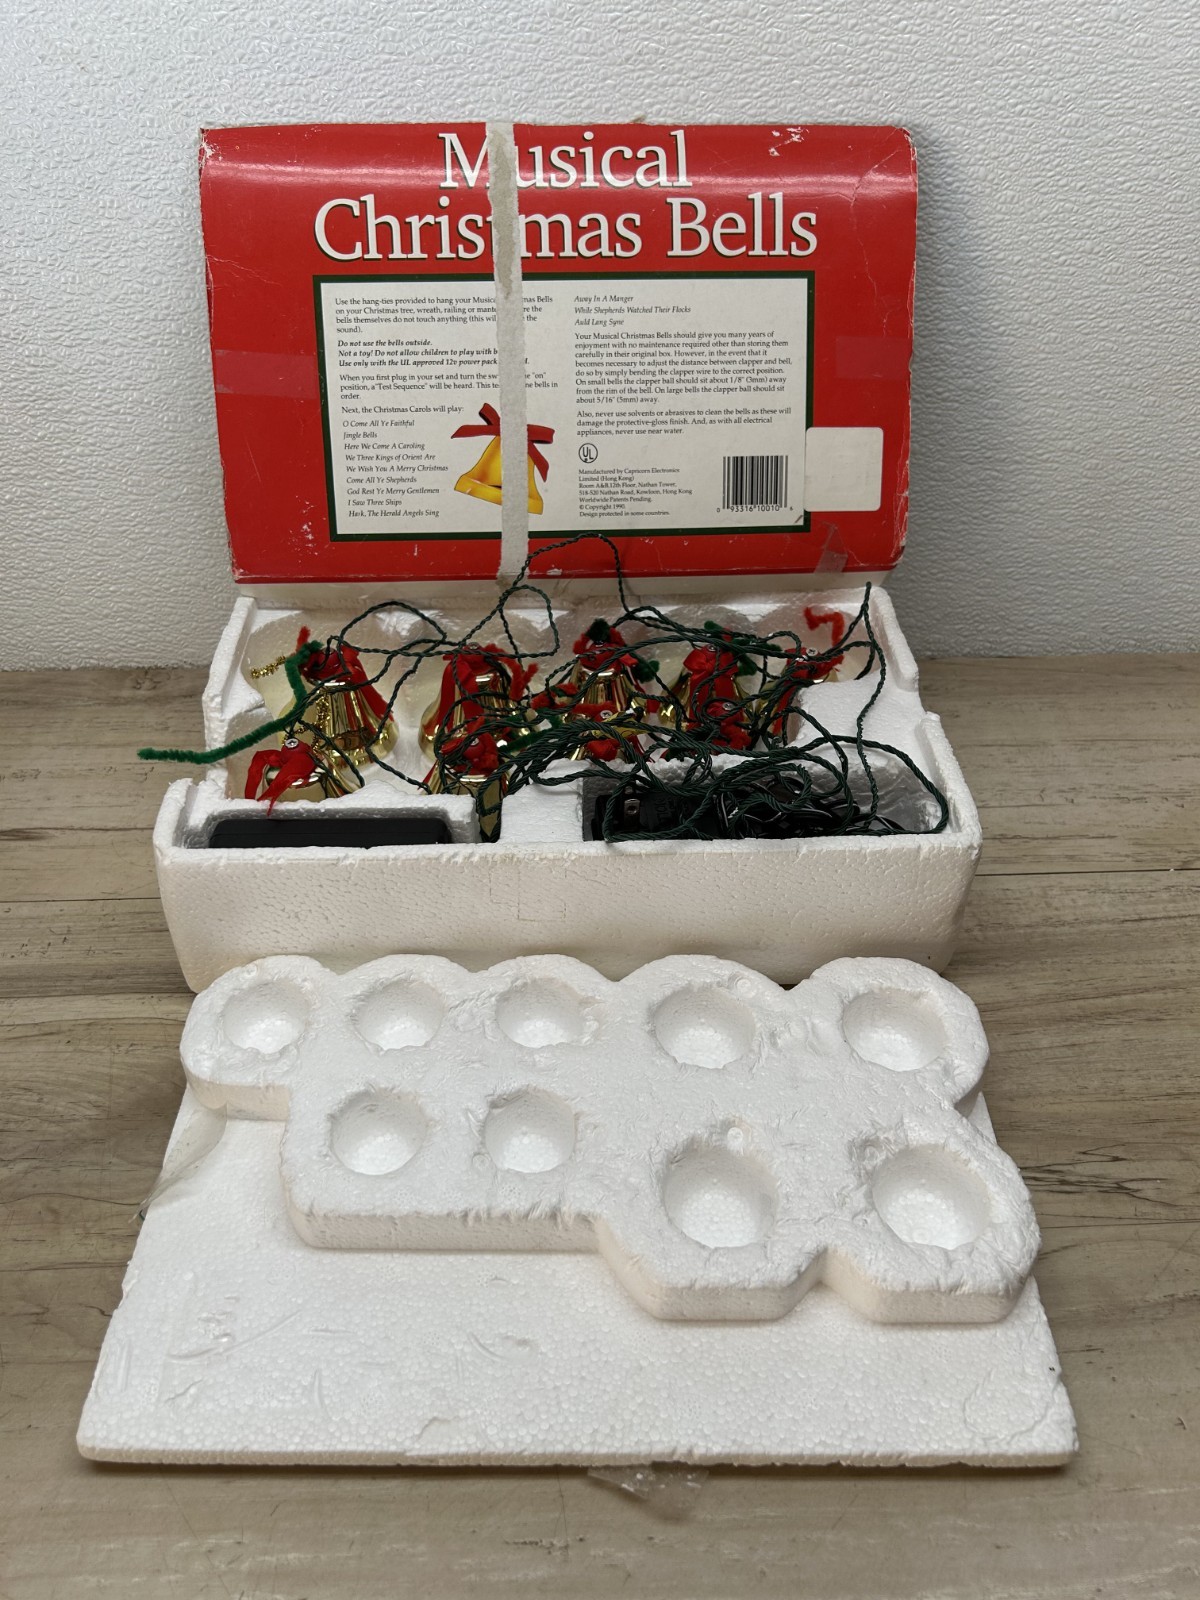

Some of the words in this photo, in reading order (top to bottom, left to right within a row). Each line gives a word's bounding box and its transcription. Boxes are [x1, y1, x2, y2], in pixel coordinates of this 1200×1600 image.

[438, 129, 692, 188] Musical
[314, 193, 642, 260] Chrismas
[666, 192, 817, 257] Bells
[395, 296, 427, 305] provided
[436, 296, 454, 305] hang
[574, 295, 593, 304] Away
[609, 294, 634, 304] Manger
[444, 306, 467, 315] railing
[594, 306, 625, 315] Shepherds
[437, 315, 468, 324] anything
[468, 315, 485, 324] (this
[591, 318, 608, 327] Lang
[609, 318, 625, 327] Syne
[698, 331, 713, 340] give
[574, 341, 610, 350] enjoyment
[682, 340, 711, 349] required
[747, 339, 771, 348] storing
[459, 348, 474, 357] play
[574, 350, 605, 359] carefully
[631, 350, 658, 359] original
[353, 359, 369, 368] only
[412, 358, 445, 367] approved
[481, 357, 498, 366] pack
[647, 359, 668, 368] adjust
[738, 358, 763, 367] clapper
[604, 368, 628, 377] simply
[629, 368, 657, 377] bending
[670, 368, 695, 377] clapper
[391, 373, 408, 382] plug
[636, 377, 661, 386] clapper
[393, 382, 428, 391] Sequence"
[666, 386, 684, 395] large
[713, 385, 738, 394] clapper
[447, 405, 464, 414] play:
[390, 419, 415, 428] Faithful
[576, 419, 604, 428] damage
[343, 431, 362, 440] Jingle
[398, 442, 426, 451] Caroling
[375, 453, 394, 462] Kings
[396, 464, 416, 473] Merry
[386, 476, 417, 485] Shepherds
[386, 487, 406, 496] Merry
[385, 498, 402, 507] Ships
[402, 509, 424, 518] Angels
[425, 509, 440, 518] Sing
